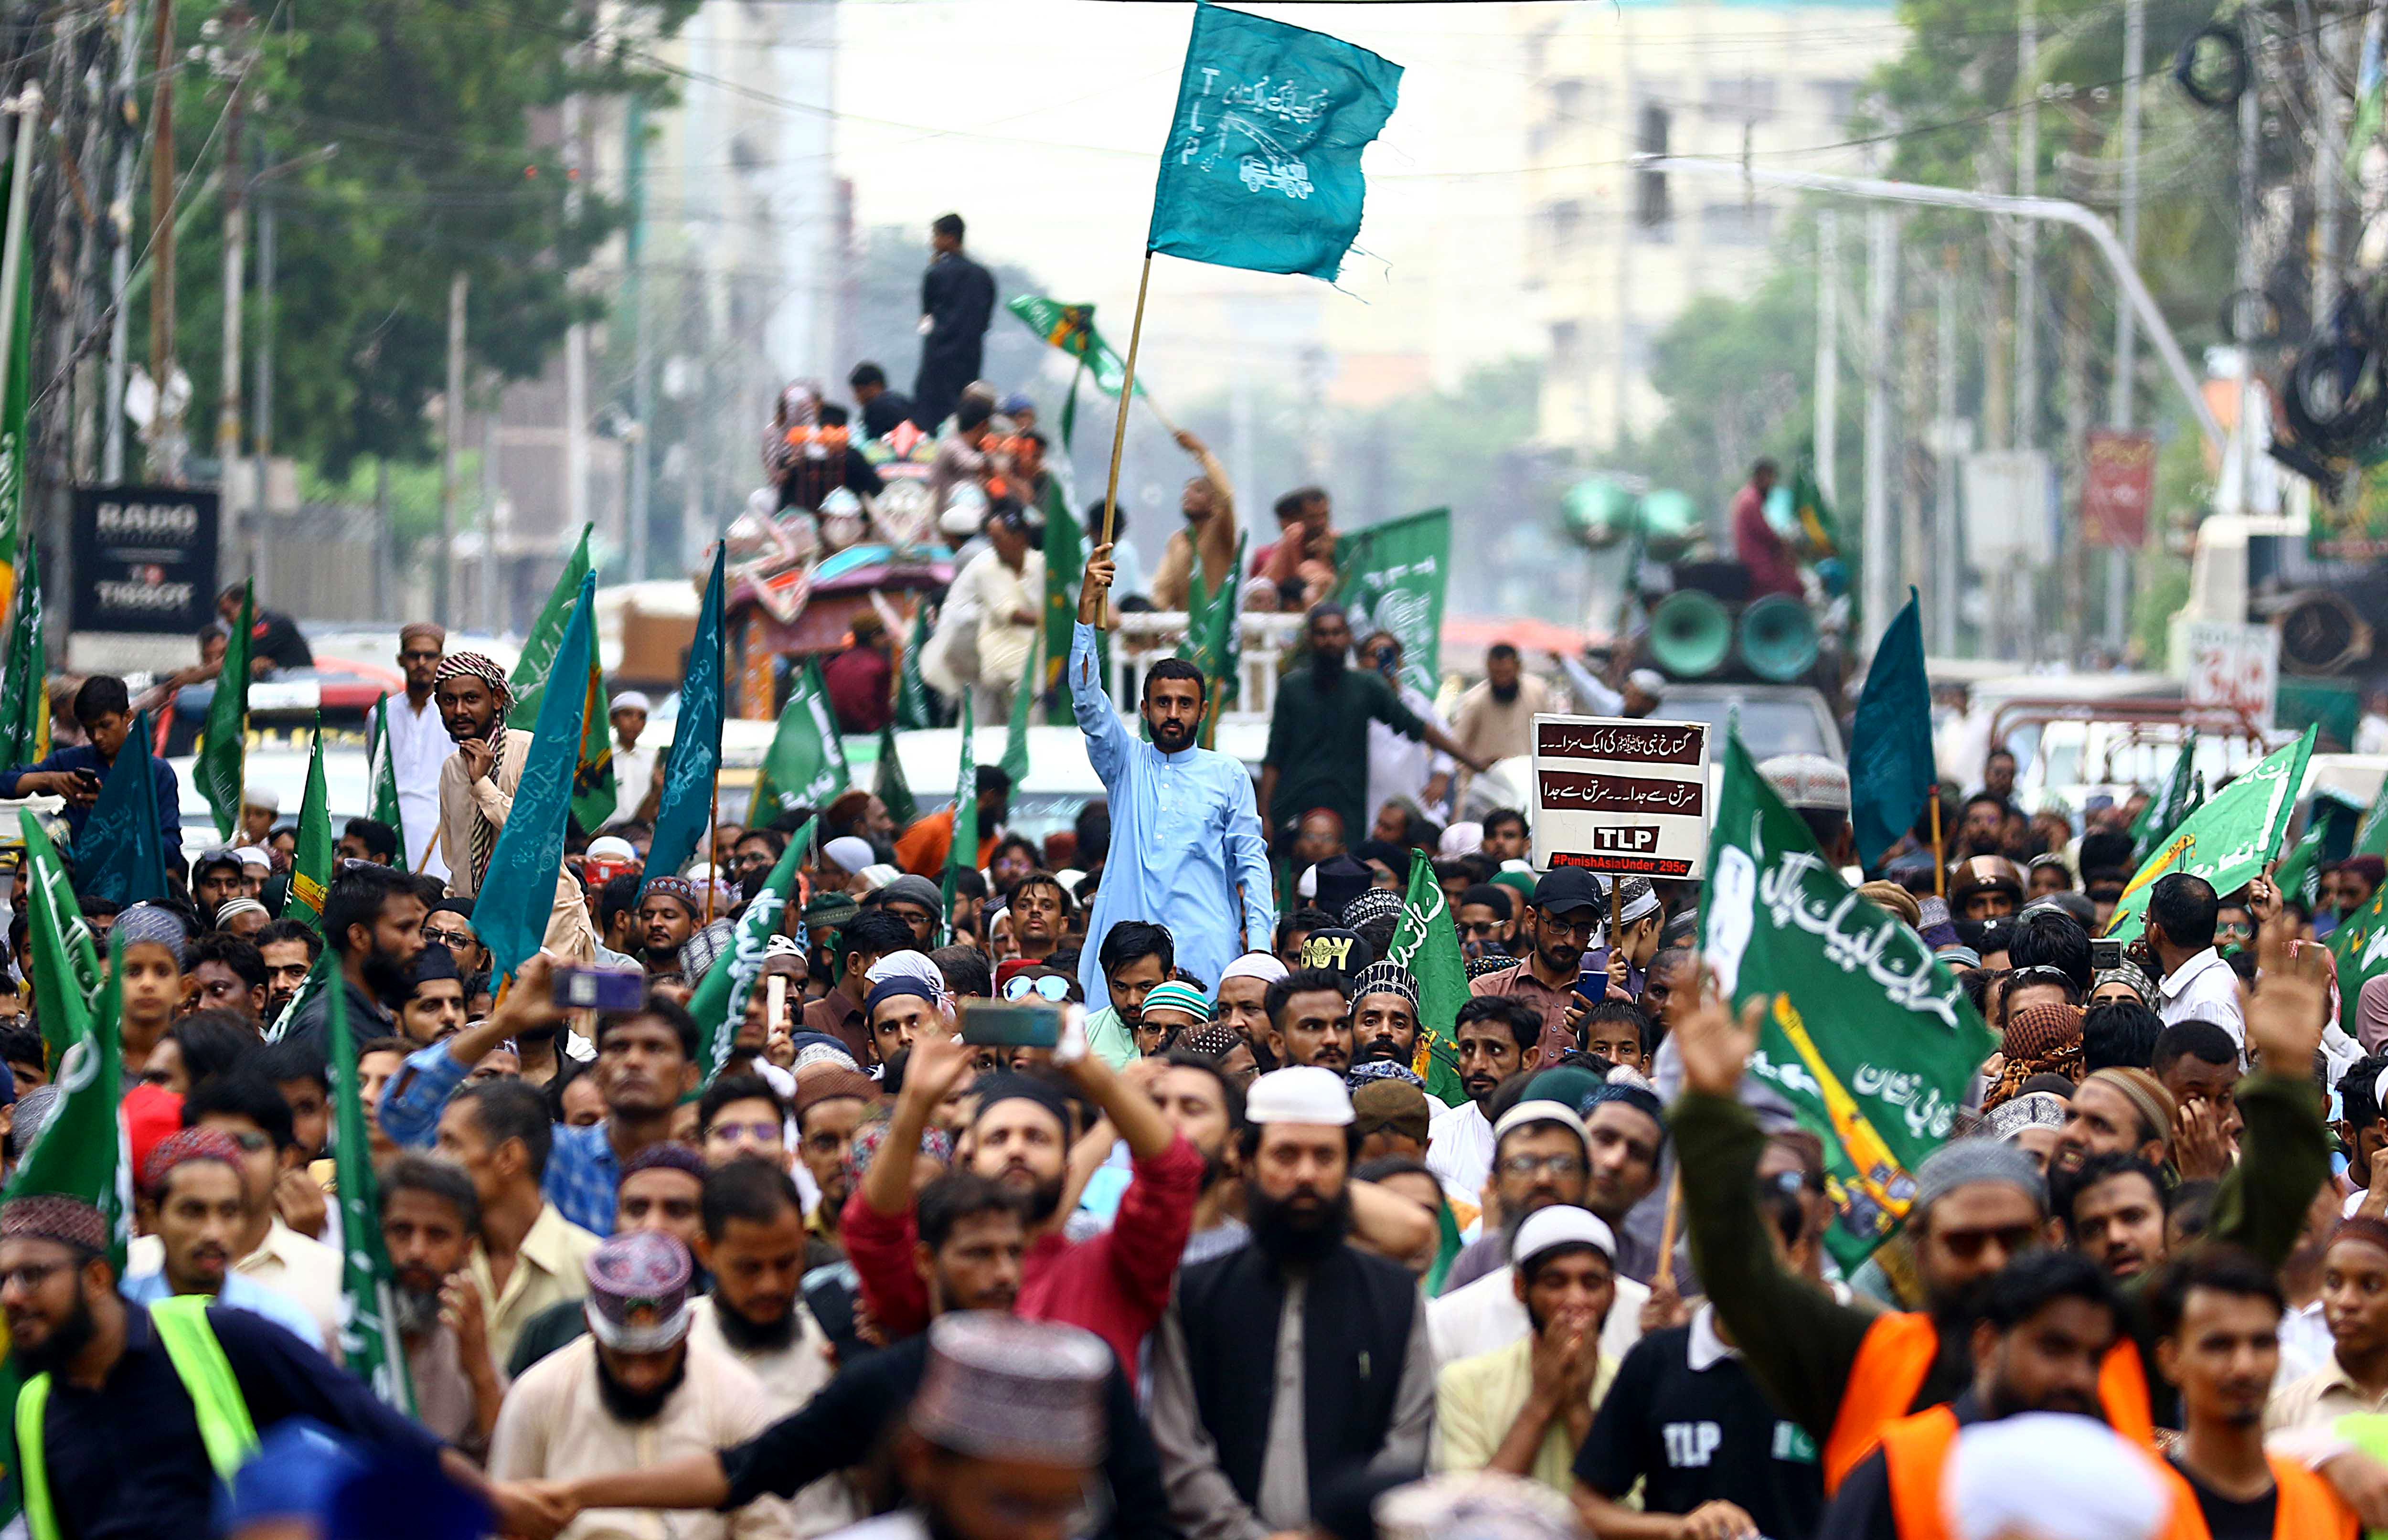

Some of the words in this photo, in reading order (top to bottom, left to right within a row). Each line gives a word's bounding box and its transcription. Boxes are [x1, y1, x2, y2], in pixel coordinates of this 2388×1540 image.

[1579, 729, 1604, 750] ایک
[1604, 729, 1617, 753] کی
[1643, 734, 1659, 755] نبی
[1659, 733, 1692, 755] گستاخ
[1544, 782, 1560, 800] جدا
[1598, 828, 1652, 850] TLP
[1553, 854, 1688, 873] #PunishAsiaUnder_295c
[1301, 936, 1354, 970] BOY
[1662, 1420, 1722, 1468] TLP
